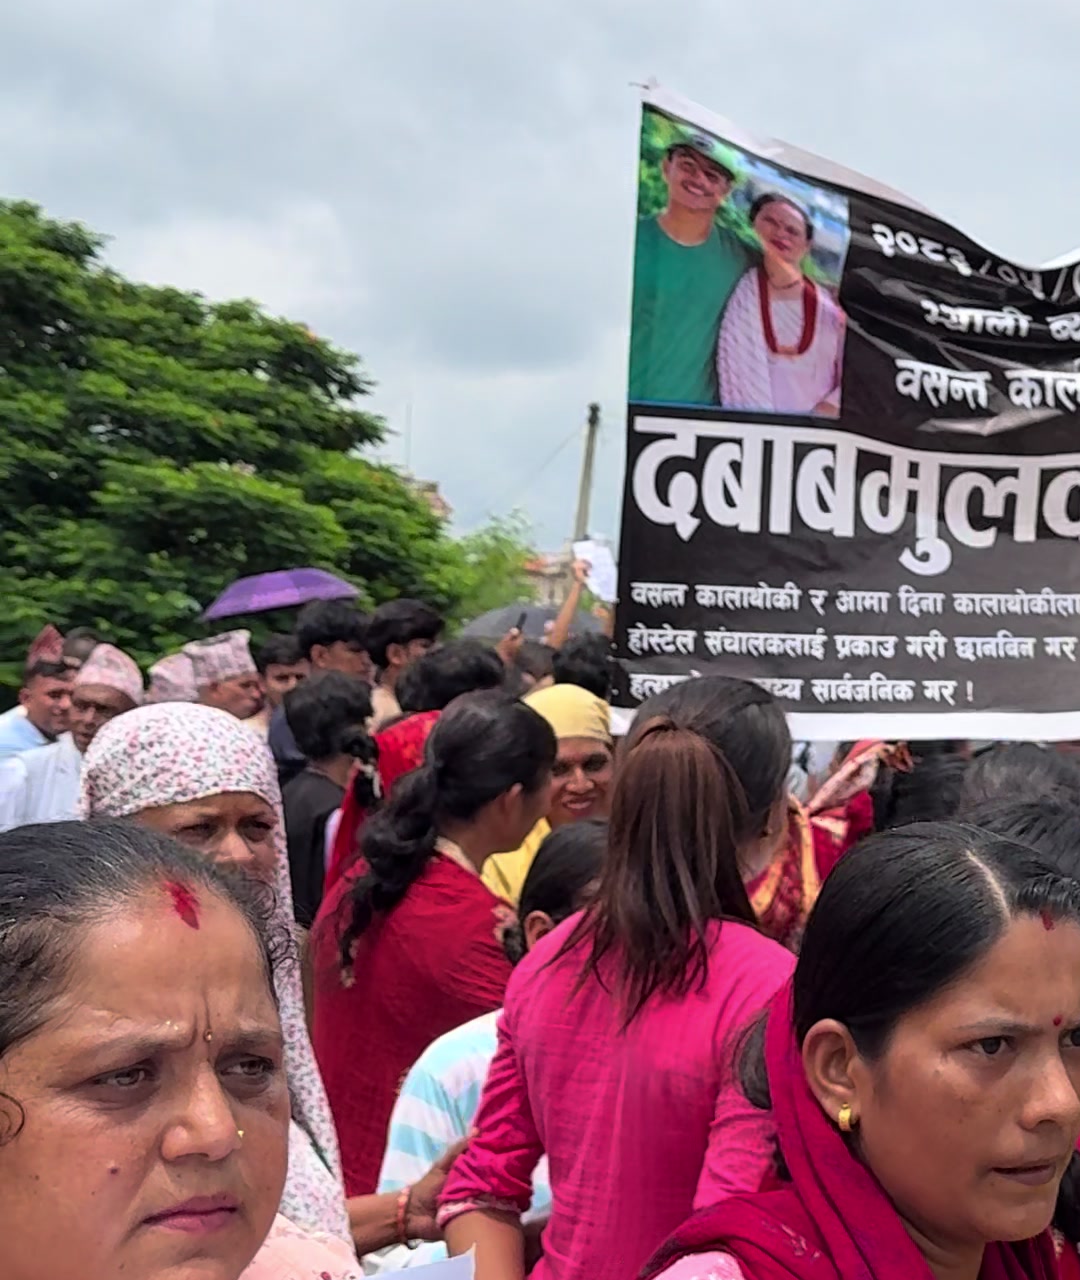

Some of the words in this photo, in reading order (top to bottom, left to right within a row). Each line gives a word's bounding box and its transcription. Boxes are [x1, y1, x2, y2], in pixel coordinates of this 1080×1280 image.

[808, 589, 828, 616] र
[835, 590, 891, 613] आमा
[627, 623, 697, 655] होस्टेल
[905, 629, 948, 662] गरी
[1043, 636, 1078, 661] गर
[922, 680, 958, 706] गर
